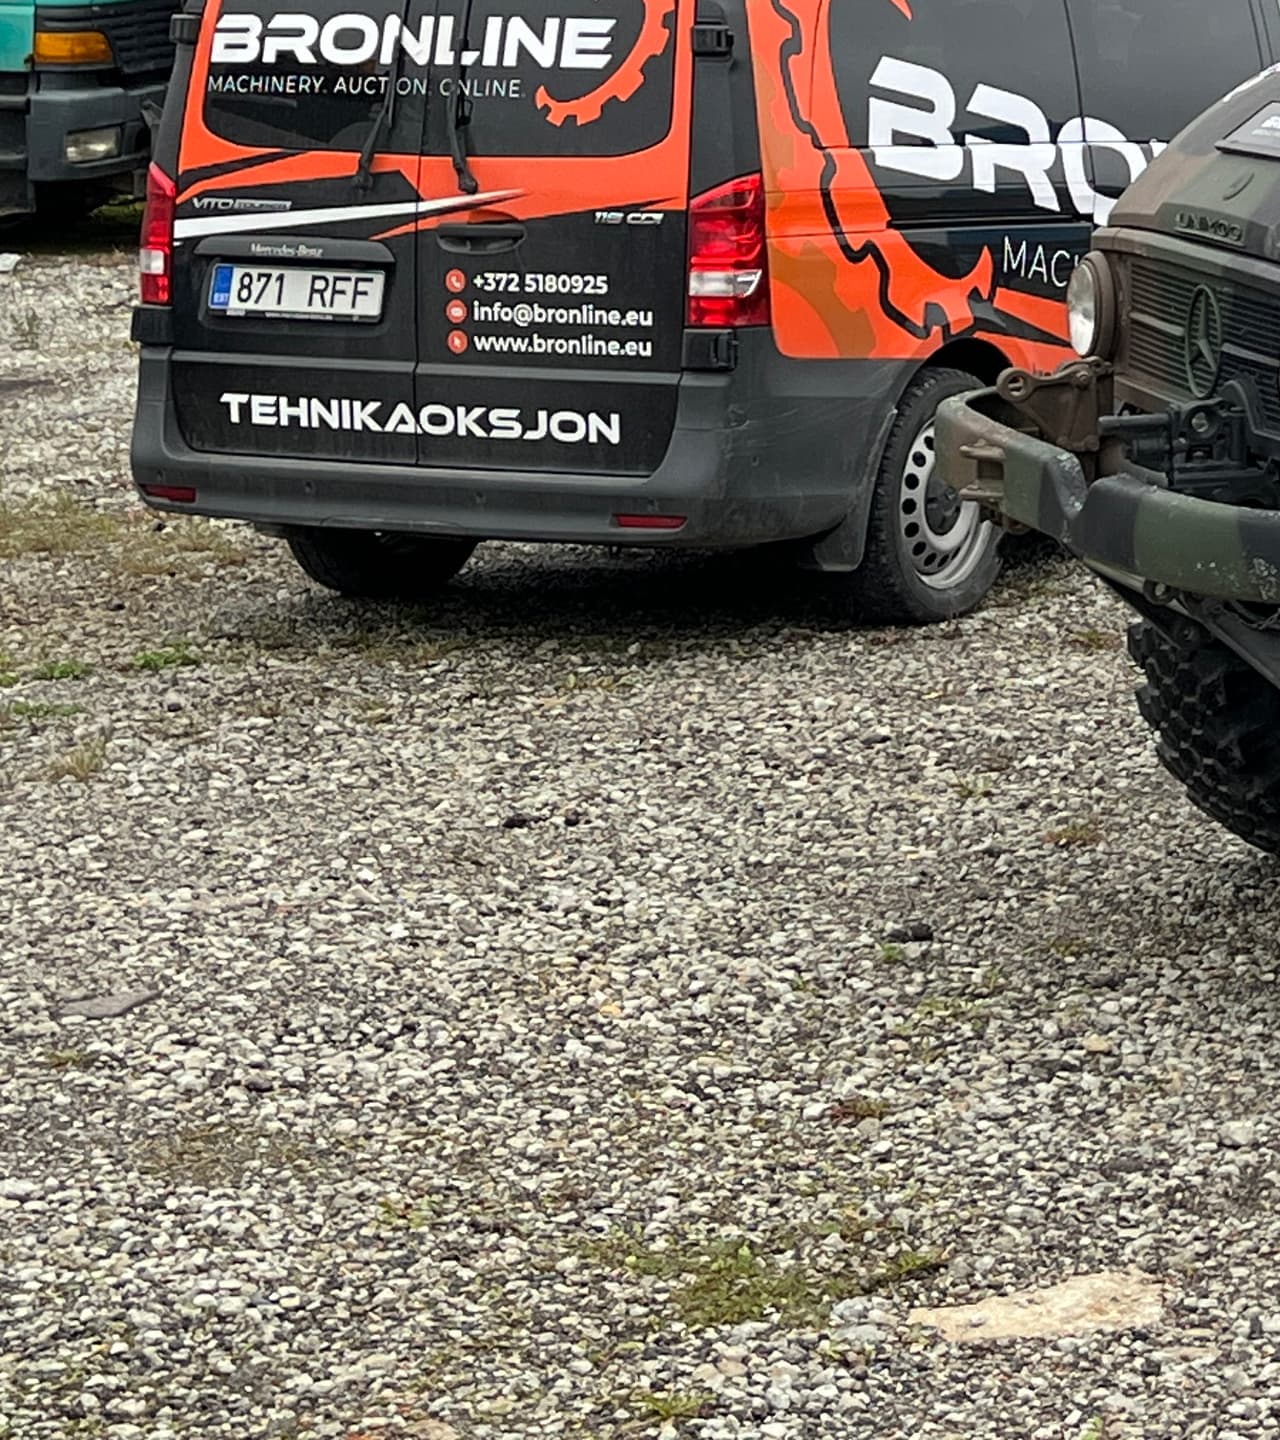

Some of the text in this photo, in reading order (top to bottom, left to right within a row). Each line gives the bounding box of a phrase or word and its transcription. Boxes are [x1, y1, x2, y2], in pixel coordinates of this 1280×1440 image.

[209, 12, 618, 69] BRONLINE
[333, 76, 431, 97] AUCTON.
[867, 55, 1170, 227] BRO
[250, 242, 324, 258] Mercedes-Benz
[1003, 235, 1080, 288] MAC
[236, 271, 374, 309] 871 RFF
[473, 271, 609, 295] +372 5180925
[473, 300, 654, 327] info@bronline.eu
[473, 333, 653, 357] www.bronline.eu
[219, 392, 621, 445] TEHNIKAOKSJON
